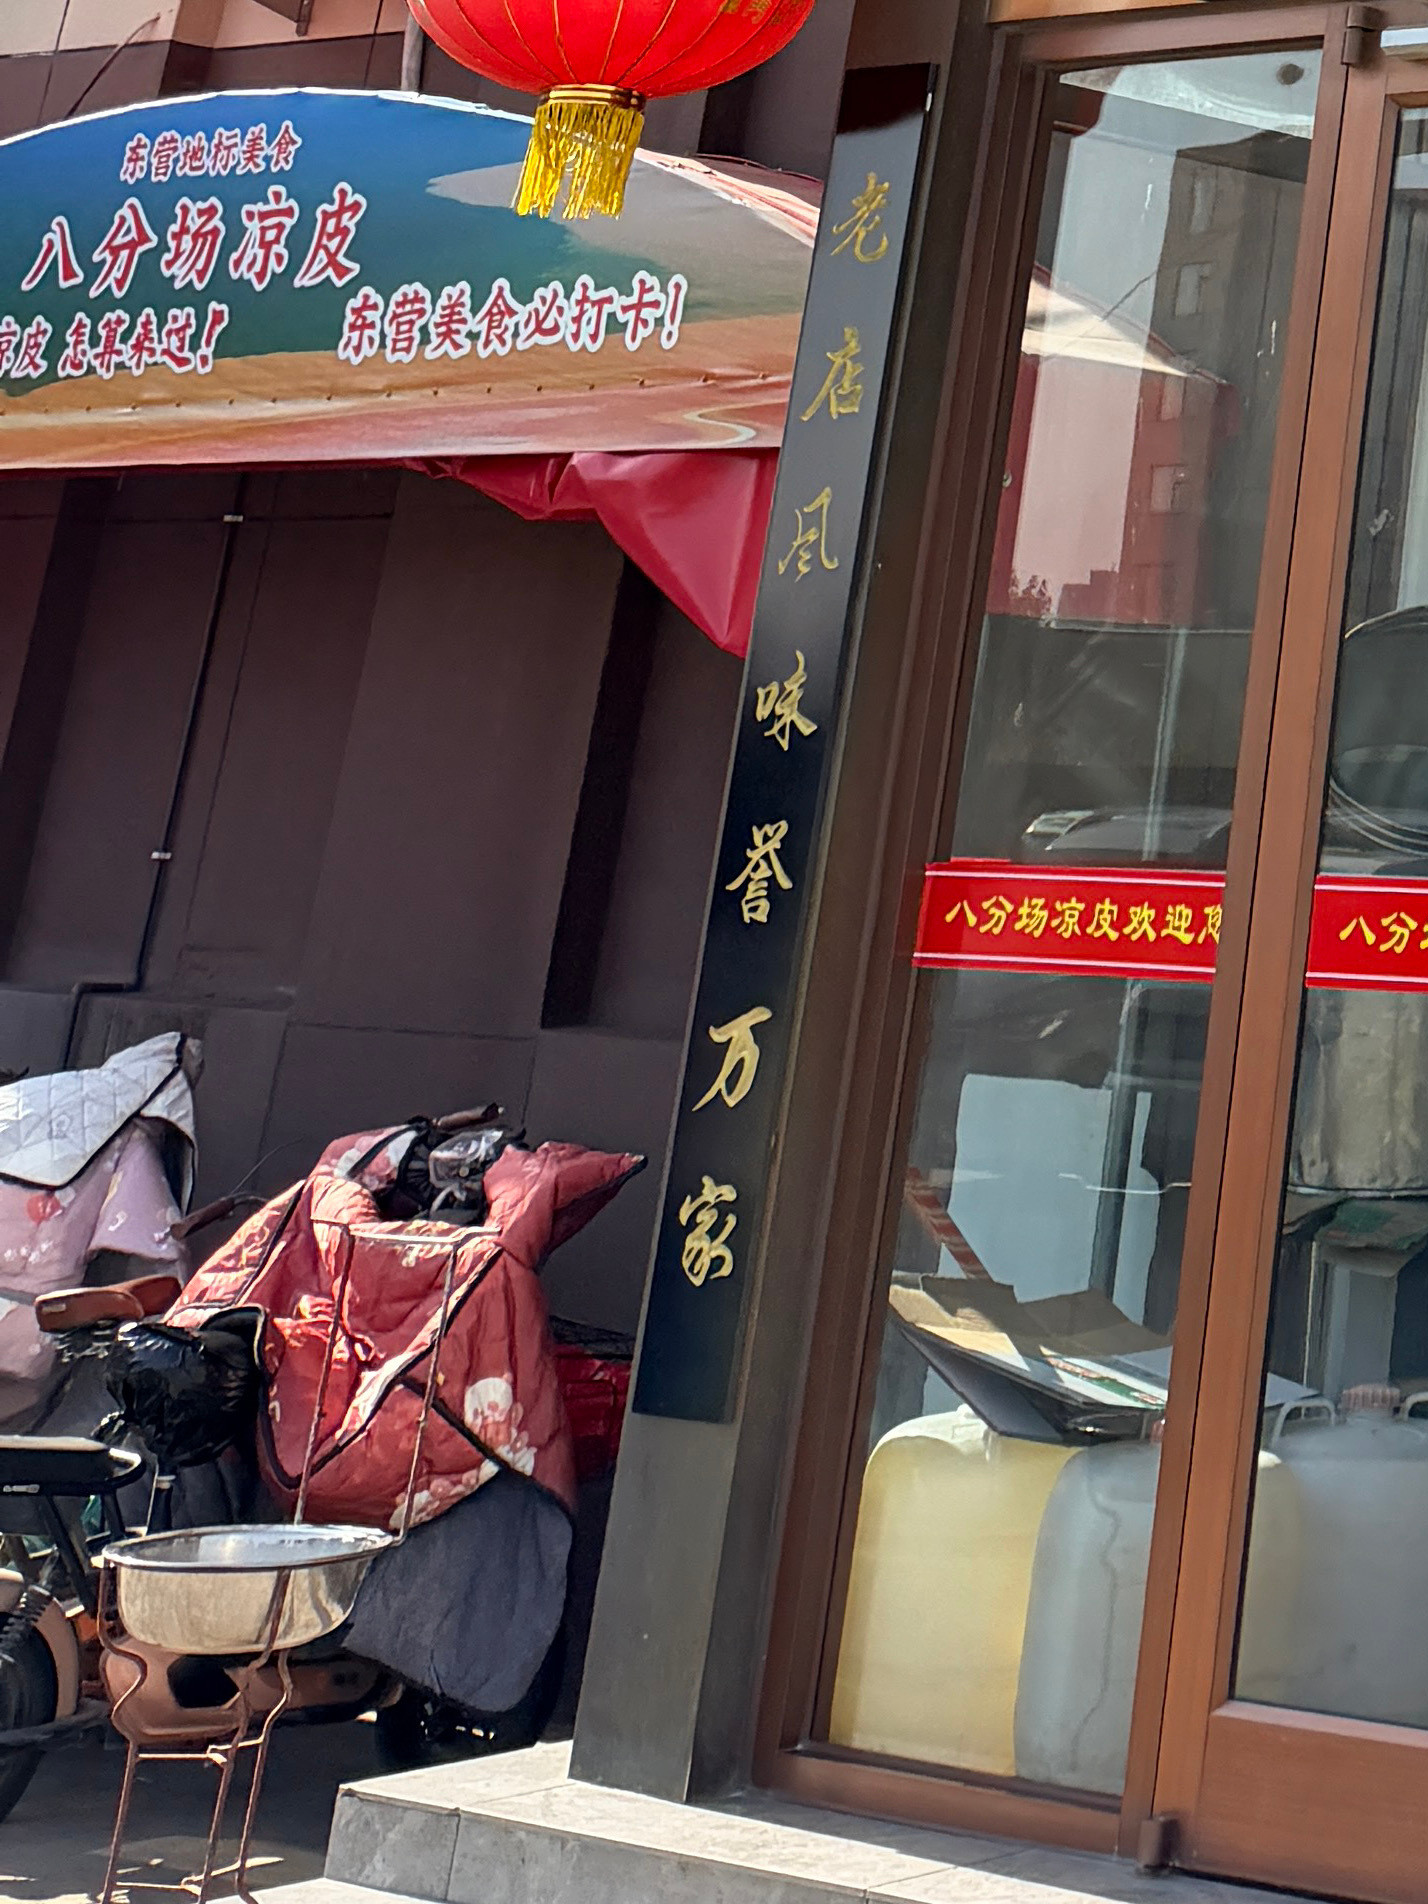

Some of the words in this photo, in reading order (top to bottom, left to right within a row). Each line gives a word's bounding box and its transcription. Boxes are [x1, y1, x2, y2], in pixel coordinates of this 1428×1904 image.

[120, 118, 303, 186] 东营地标美食
[21, 181, 369, 301] 八分场凉皮
[57, 300, 229, 380] 怎算来过！
[336, 270, 689, 367] 东营美食必打卡！
